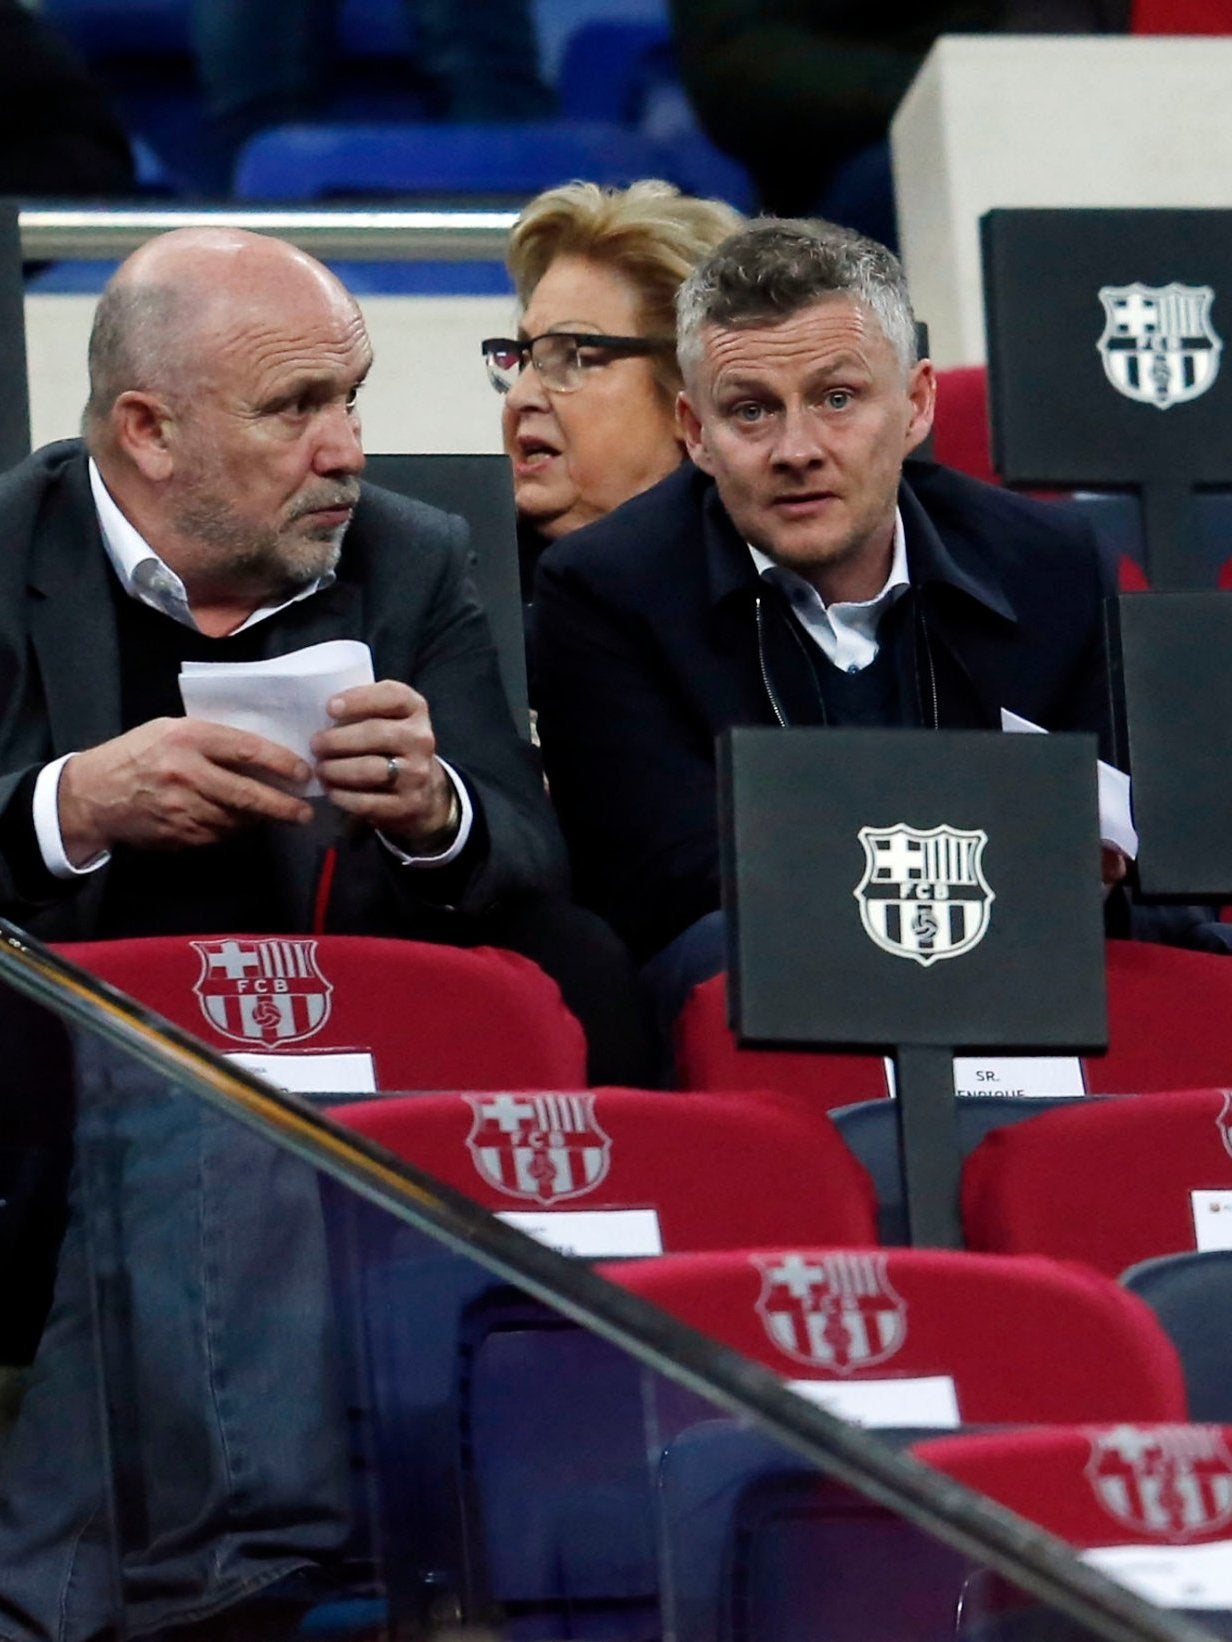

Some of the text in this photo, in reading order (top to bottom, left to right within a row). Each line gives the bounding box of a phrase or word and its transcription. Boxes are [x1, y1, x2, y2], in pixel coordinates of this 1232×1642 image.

[900, 882, 949, 899] FCB
[237, 979, 288, 993] FCB
[975, 1070, 1000, 1082] SR.
